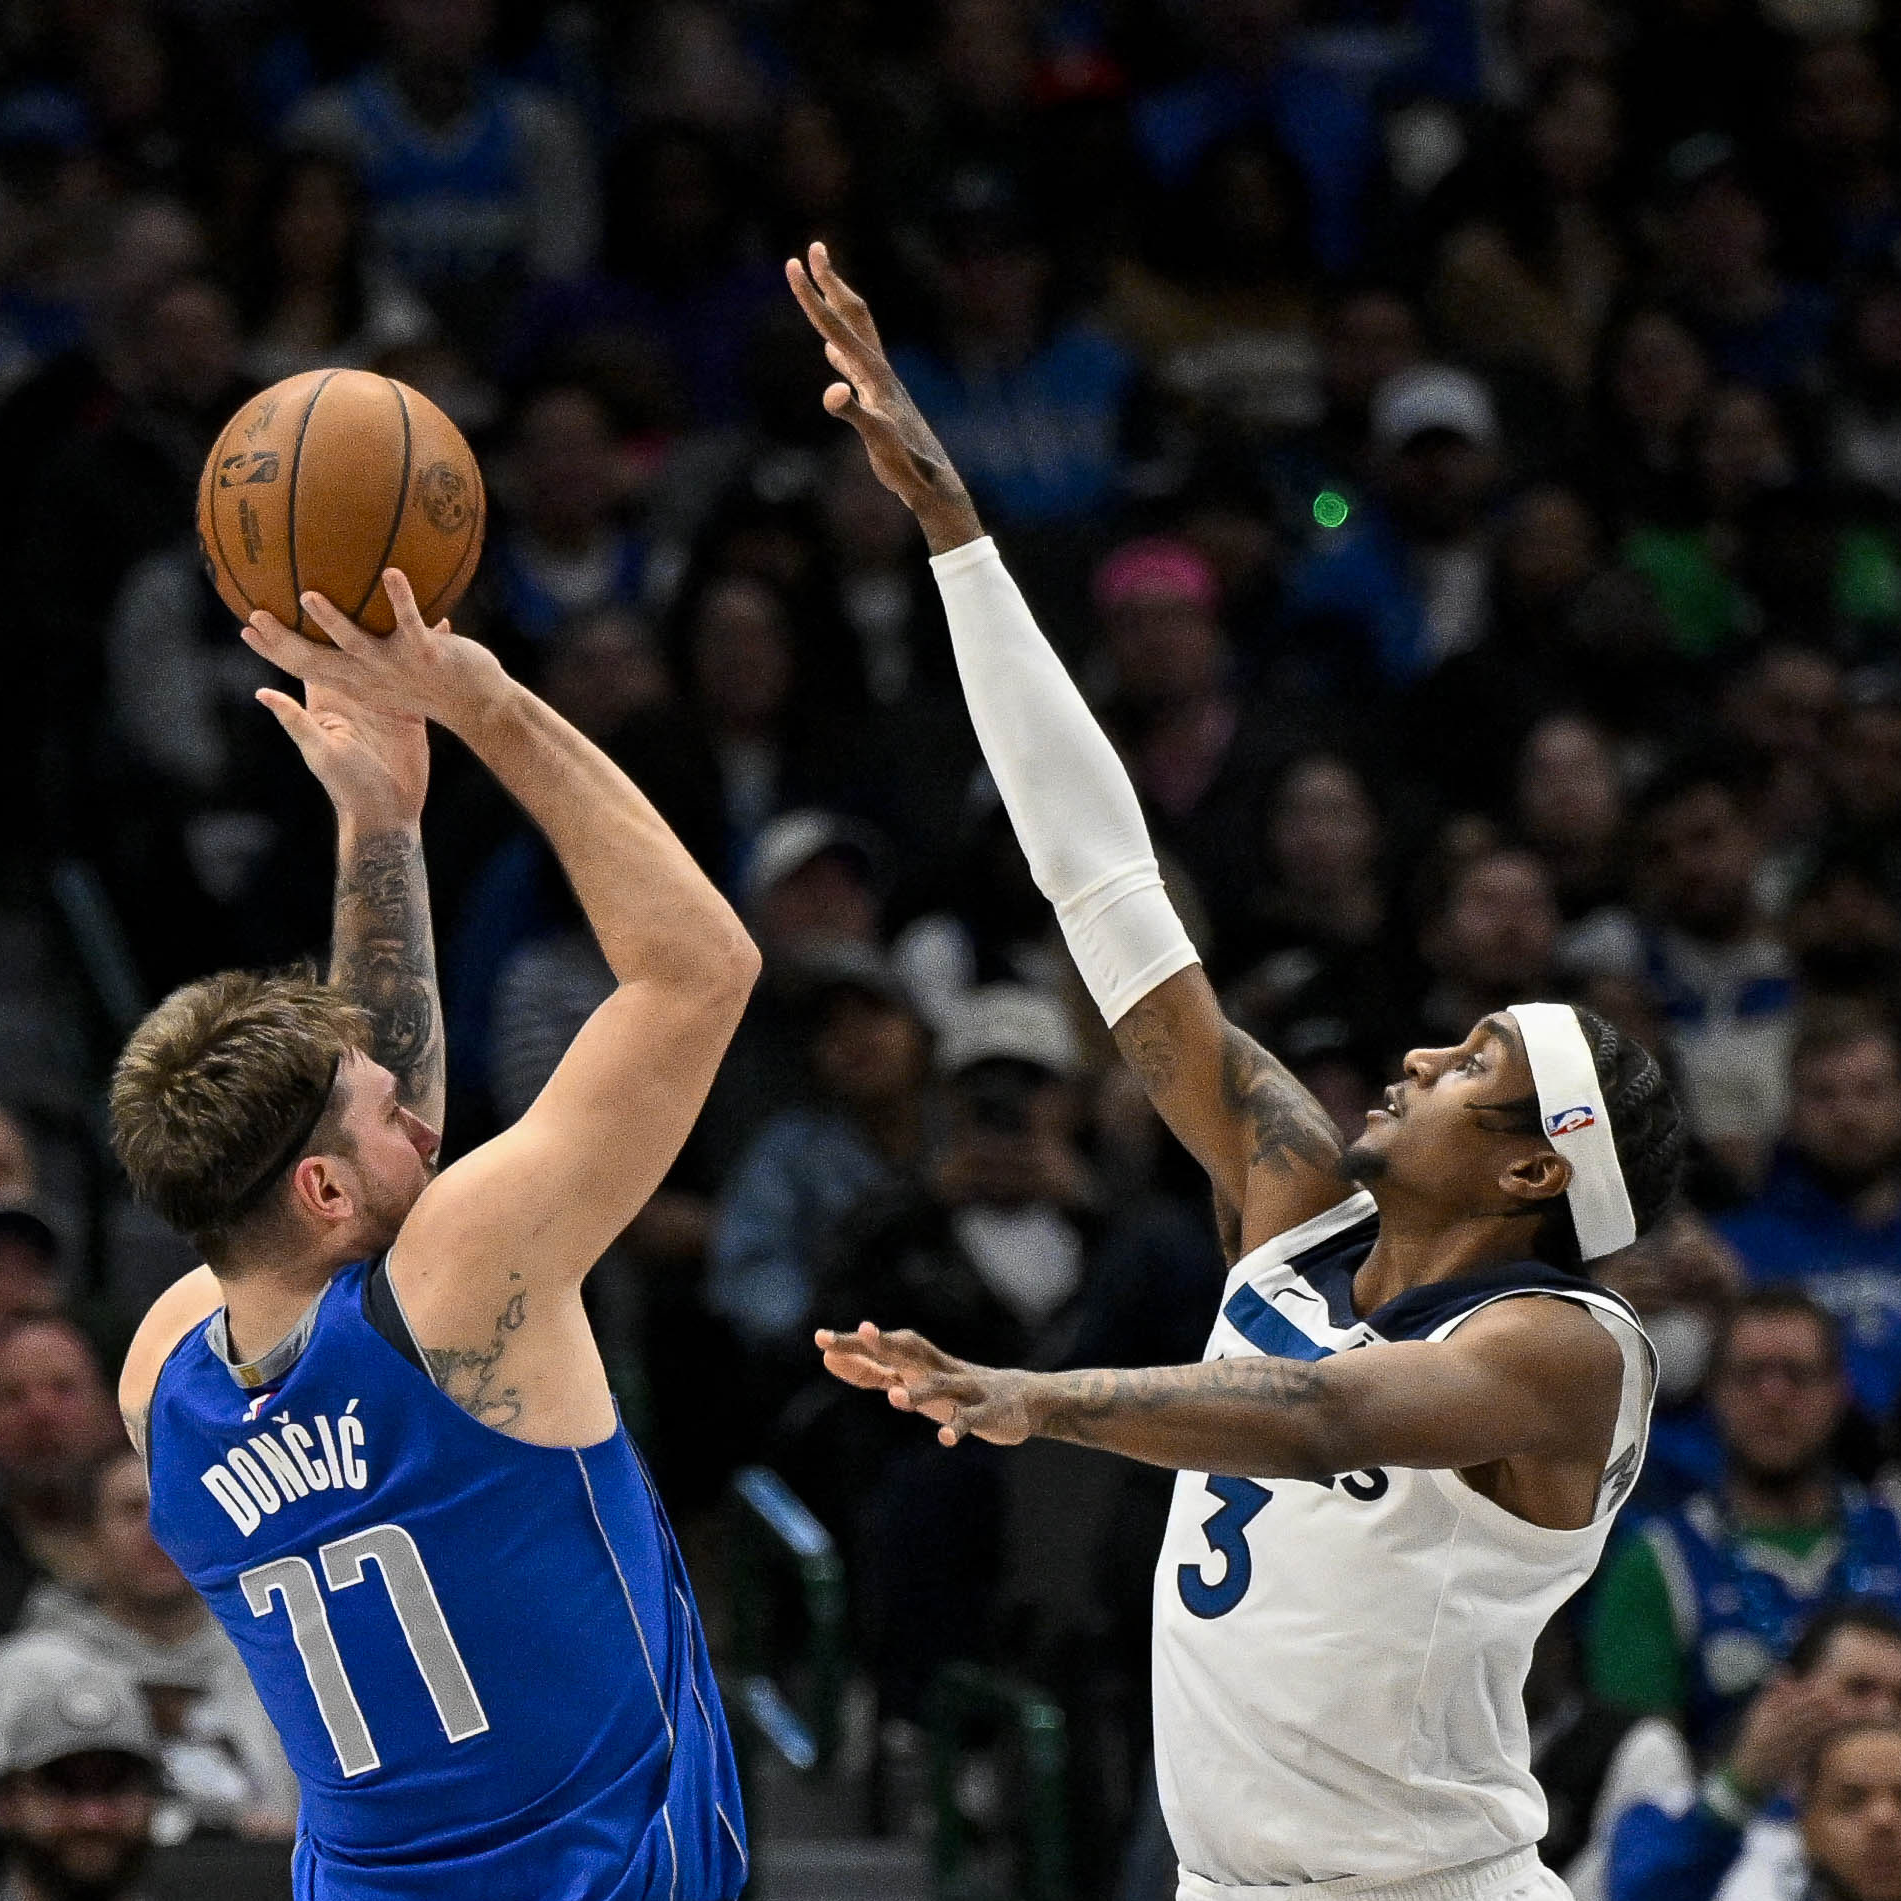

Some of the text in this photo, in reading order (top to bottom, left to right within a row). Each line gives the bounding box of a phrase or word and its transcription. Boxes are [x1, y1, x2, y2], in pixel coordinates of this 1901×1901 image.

[200, 1398, 368, 1538] DONČIĆ
[1177, 1473, 1274, 1620] 3
[239, 1524, 490, 1778] 77
